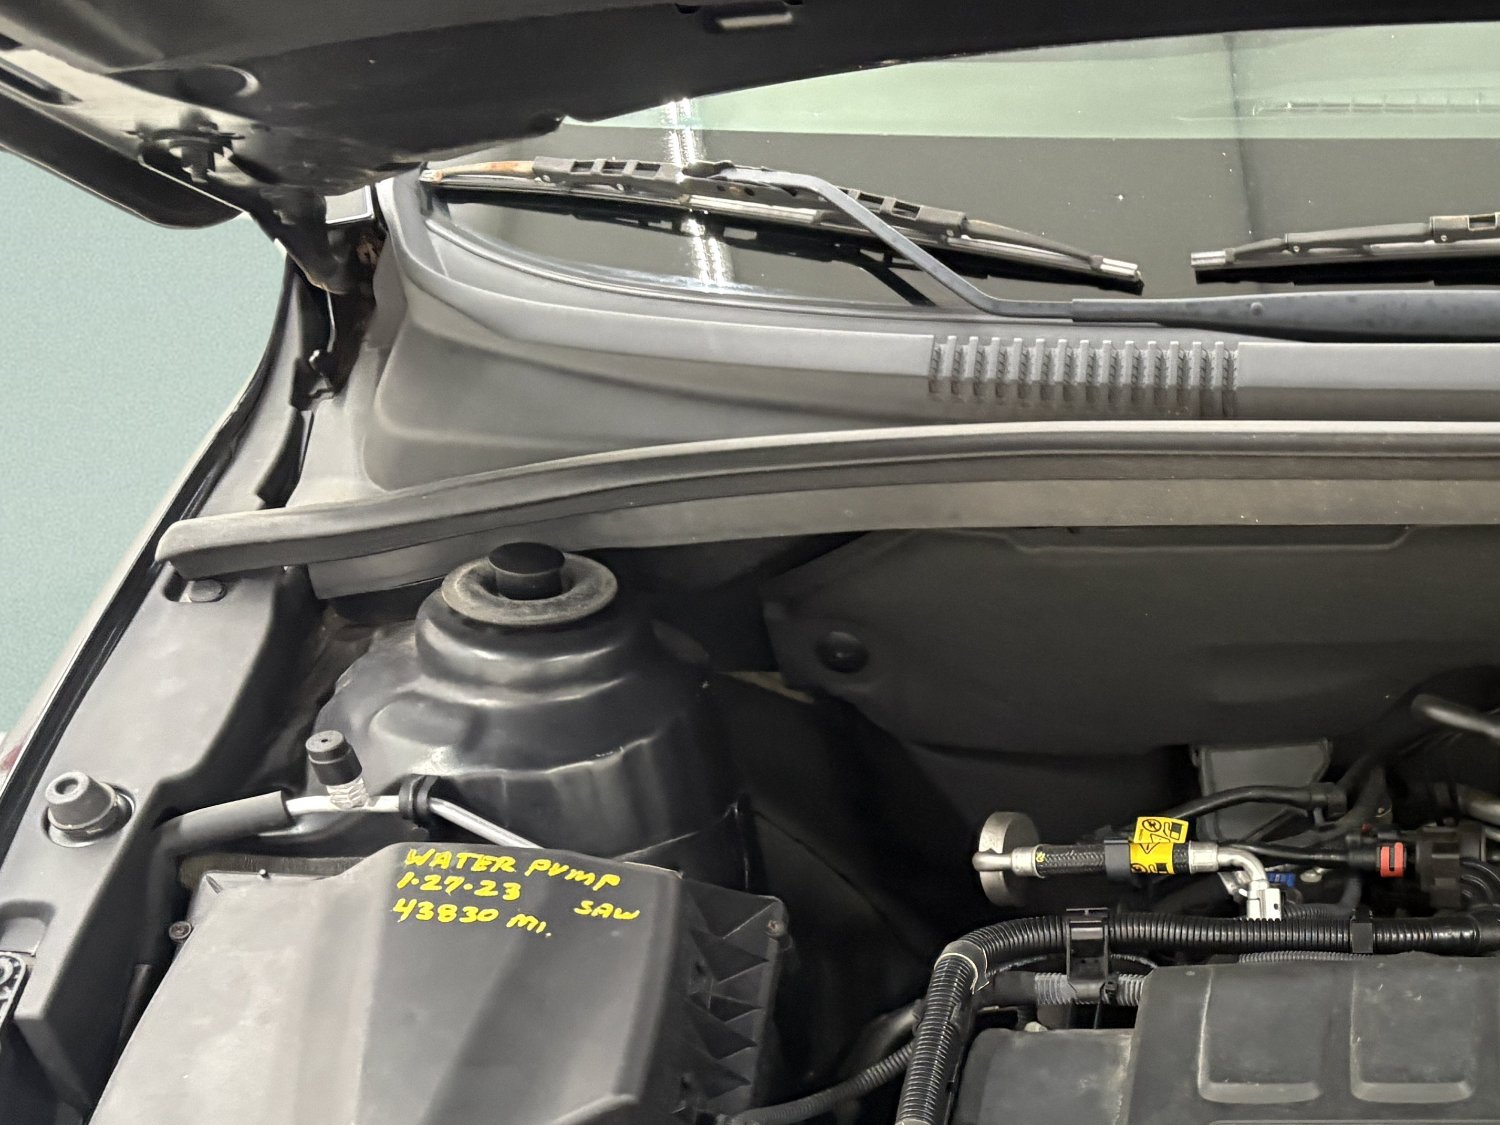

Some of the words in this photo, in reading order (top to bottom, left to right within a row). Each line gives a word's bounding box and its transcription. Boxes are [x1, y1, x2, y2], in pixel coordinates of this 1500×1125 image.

[404, 848, 517, 874] WATER
[391, 898, 499, 922] 43830
[574, 900, 640, 921] SAW
